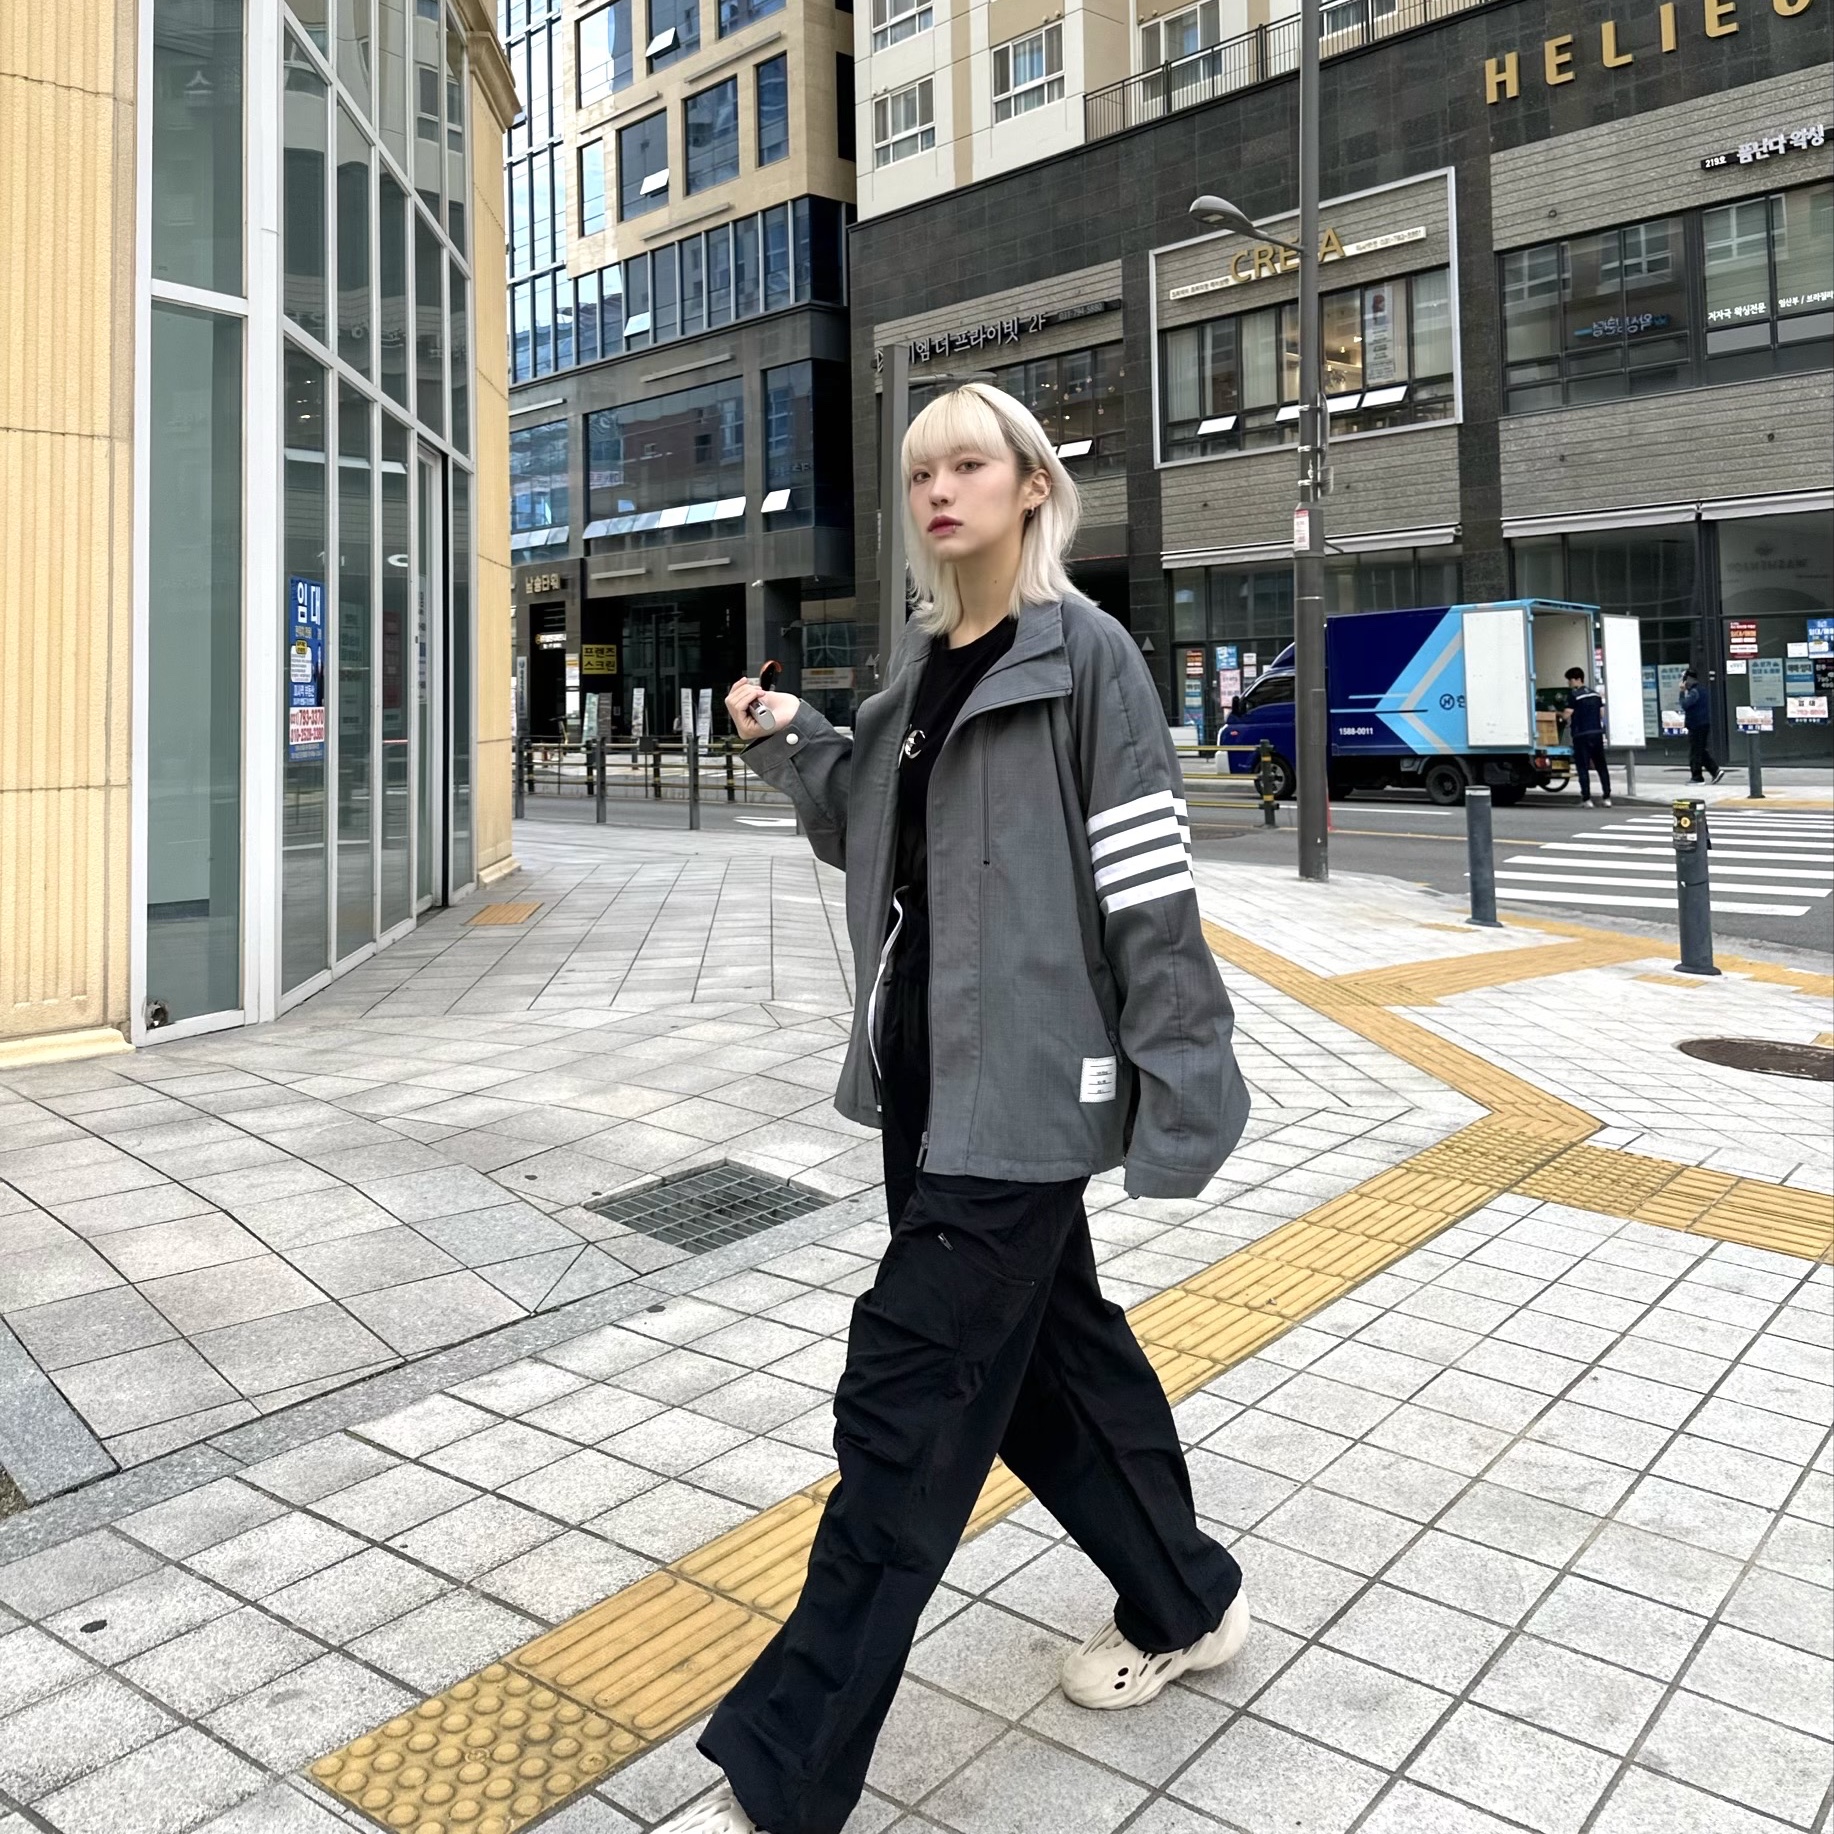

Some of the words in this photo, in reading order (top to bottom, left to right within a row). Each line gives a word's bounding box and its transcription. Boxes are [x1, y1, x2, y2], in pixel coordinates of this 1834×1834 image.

[1789, 124, 1825, 150] 왁싱
[1230, 226, 1346, 283] CREA
[1733, 302, 1767, 317] 왁싱전문
[1777, 296, 1799, 309] 임산부
[935, 333, 949, 357] 더
[953, 316, 1019, 353] 프라이빗
[1028, 312, 1047, 335] 2F
[297, 581, 321, 626] 임대
[584, 647, 615, 658] 프렌즈
[584, 660, 615, 672] 스크린
[1339, 727, 1374, 736] 1588-0011
